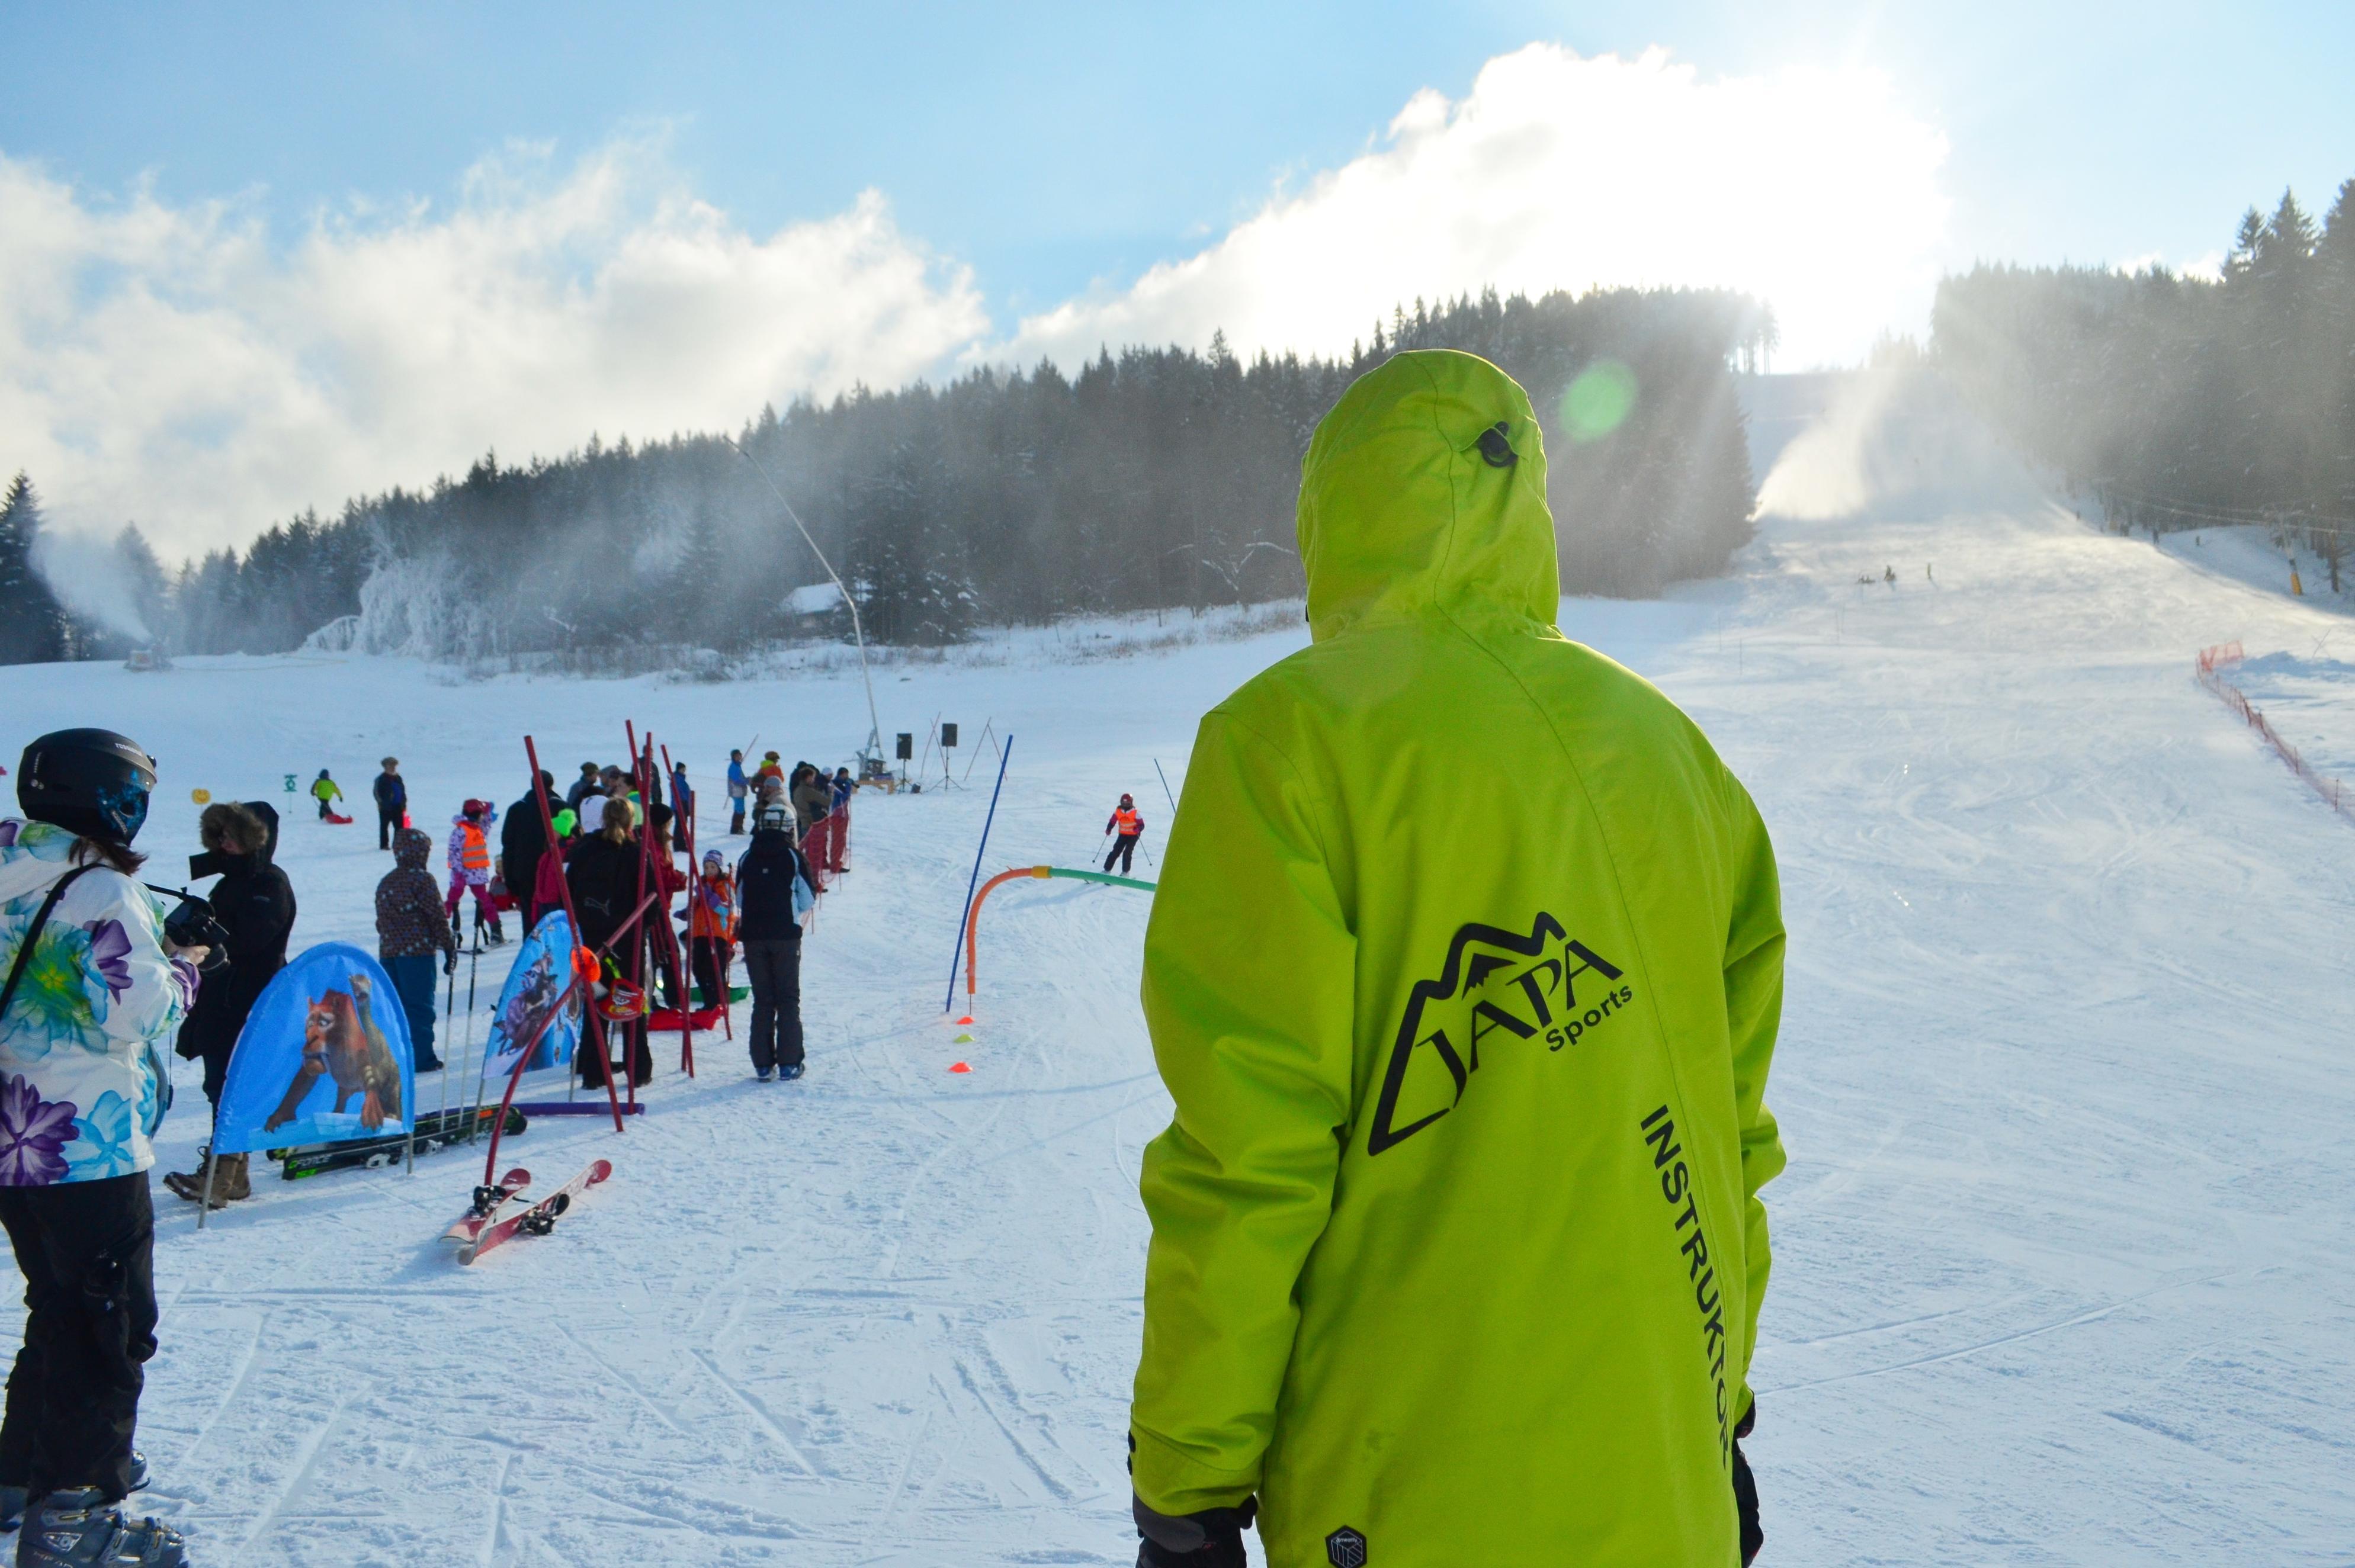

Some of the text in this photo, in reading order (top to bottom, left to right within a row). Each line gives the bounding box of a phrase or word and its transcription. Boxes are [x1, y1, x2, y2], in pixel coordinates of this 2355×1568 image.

[1414, 939, 1624, 1109] JAPA
[1545, 985, 1633, 1052] Sports
[1639, 1104, 1729, 1471] INSTRUKTOR
